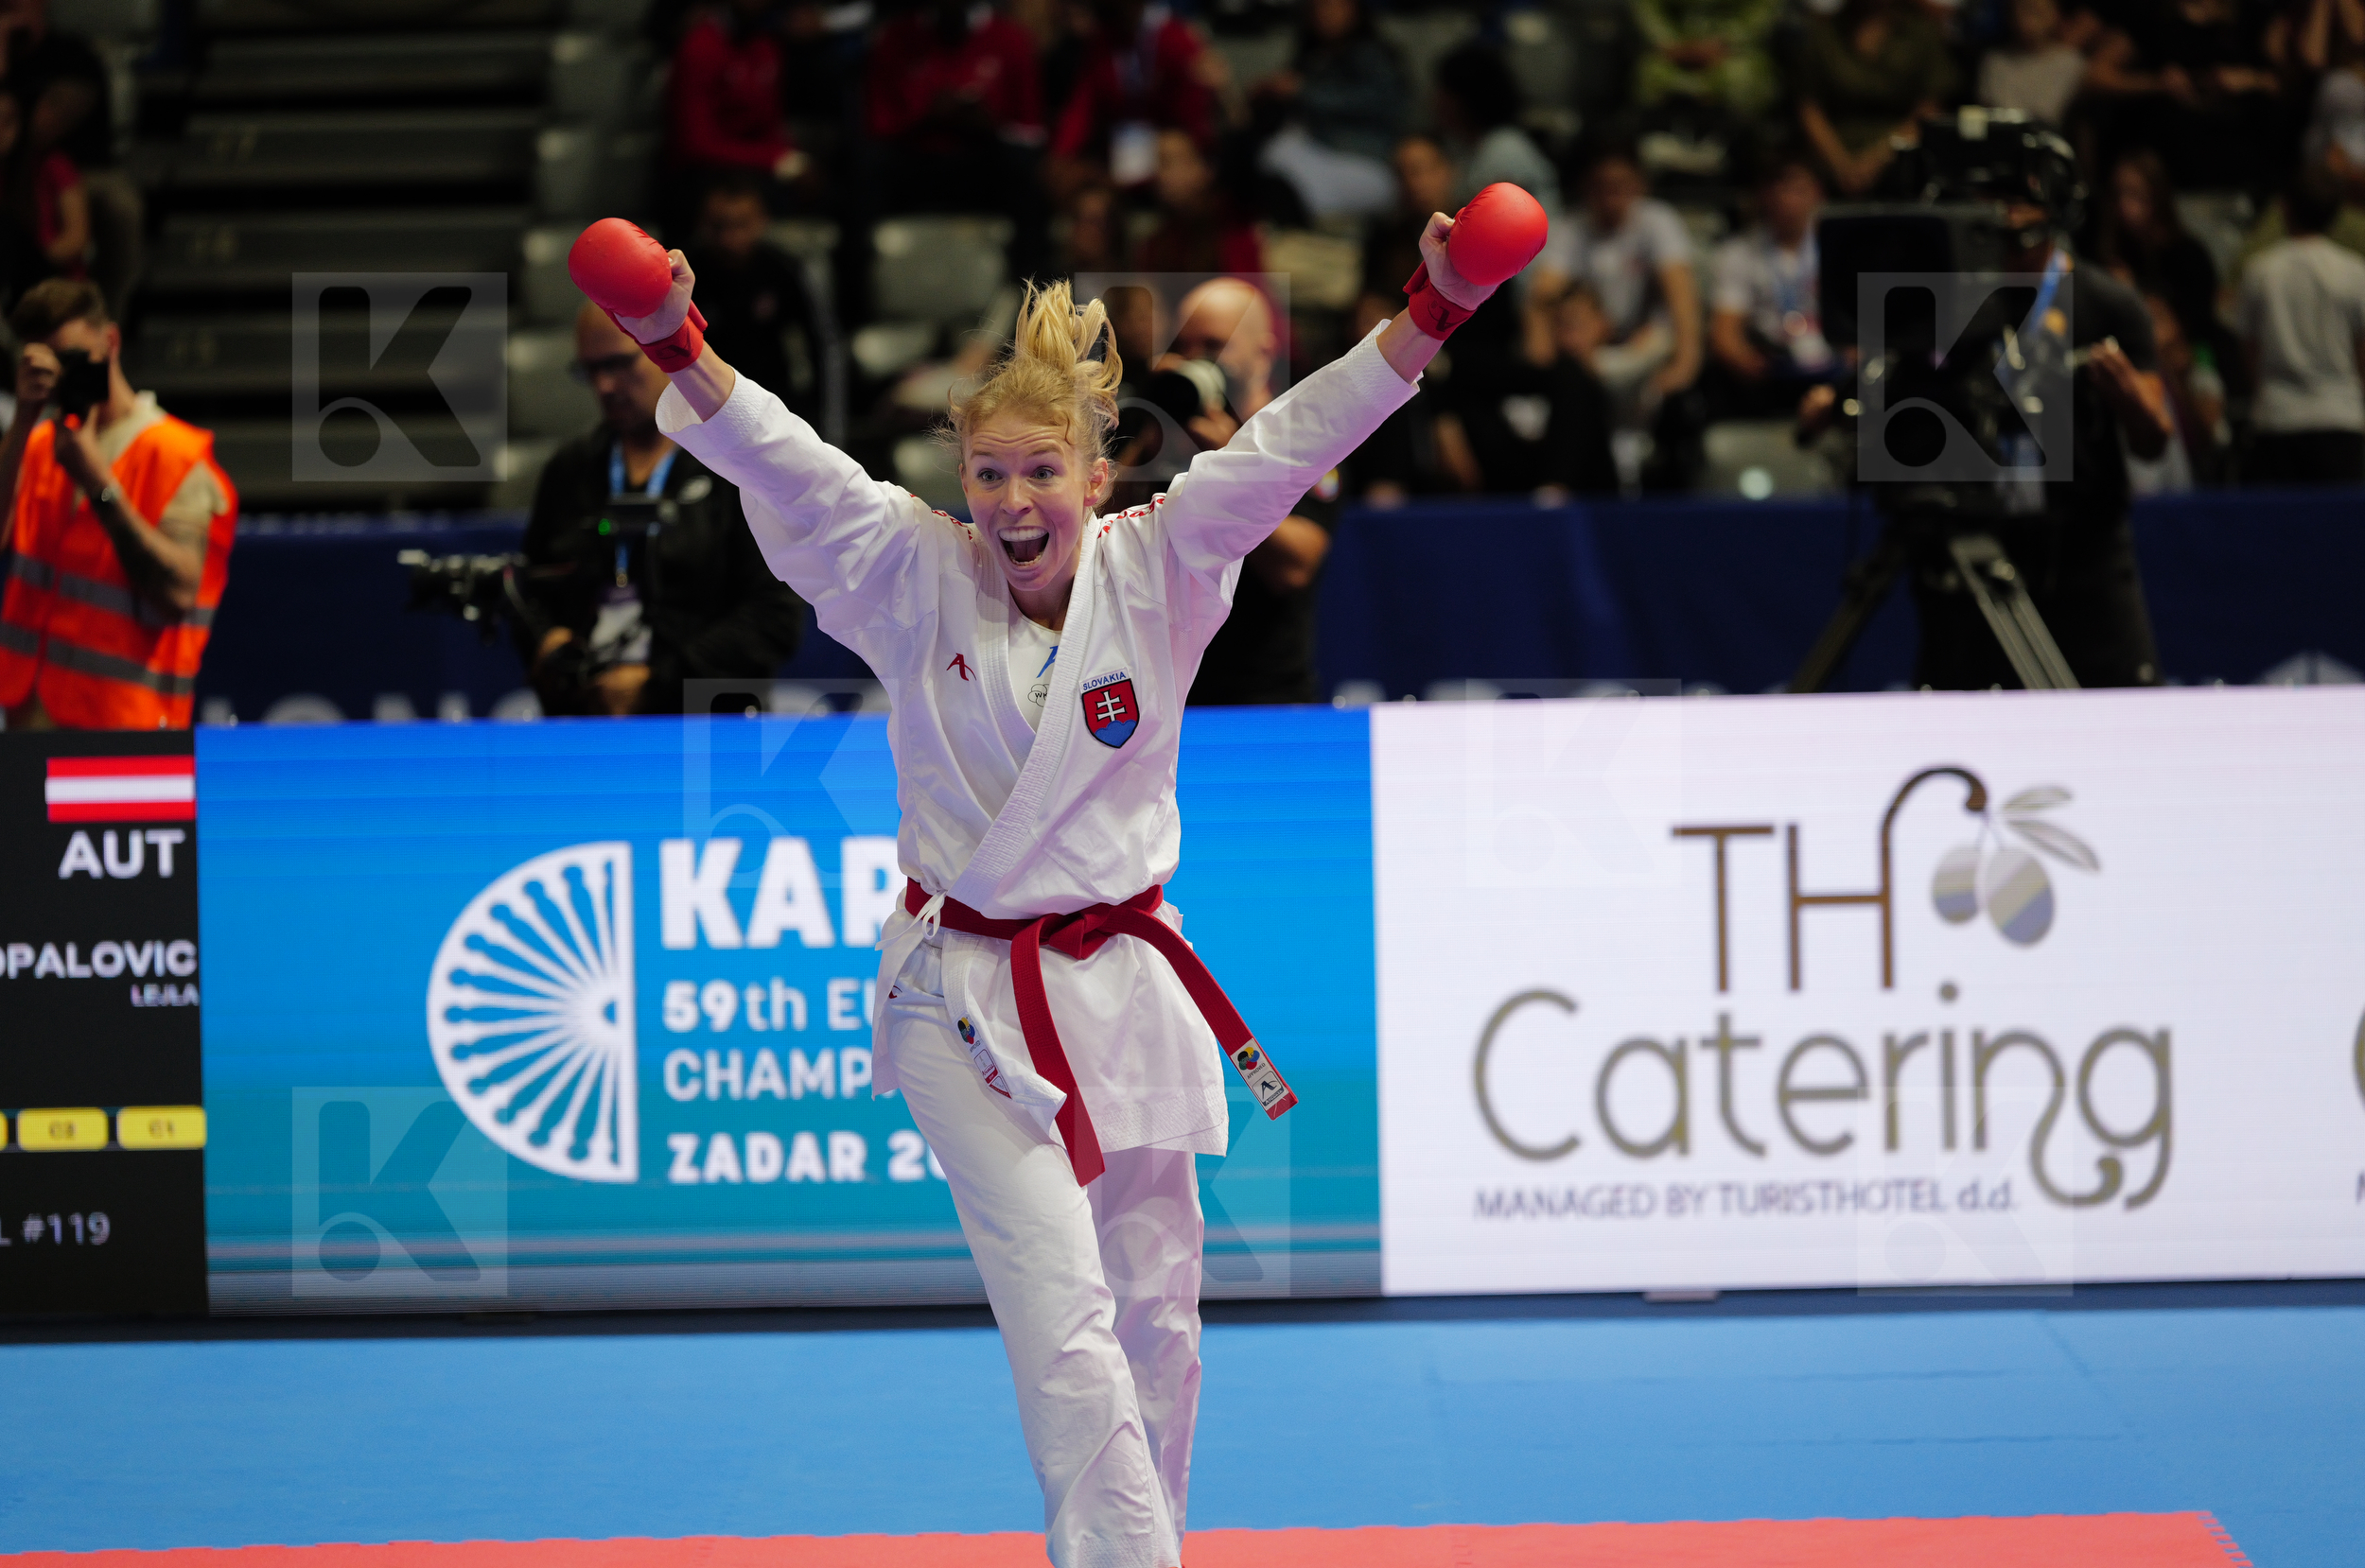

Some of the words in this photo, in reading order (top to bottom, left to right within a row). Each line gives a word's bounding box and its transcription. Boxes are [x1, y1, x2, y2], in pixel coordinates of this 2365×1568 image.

[1082, 671, 1127, 691] SLOVAKIA
[59, 828, 185, 879] AUT
[0, 939, 198, 979] PALOVIC
[664, 977, 807, 1033] 59th
[663, 1047, 897, 1101] CHAMP
[1473, 986, 2172, 1211] Catering
[667, 1130, 867, 1183] ZADAR
[1475, 1183, 1657, 1218] MANAGED
[1665, 1182, 1708, 1216] BY
[1718, 1178, 1946, 1214] TURISTHOTEL
[21, 1211, 111, 1246] #119
